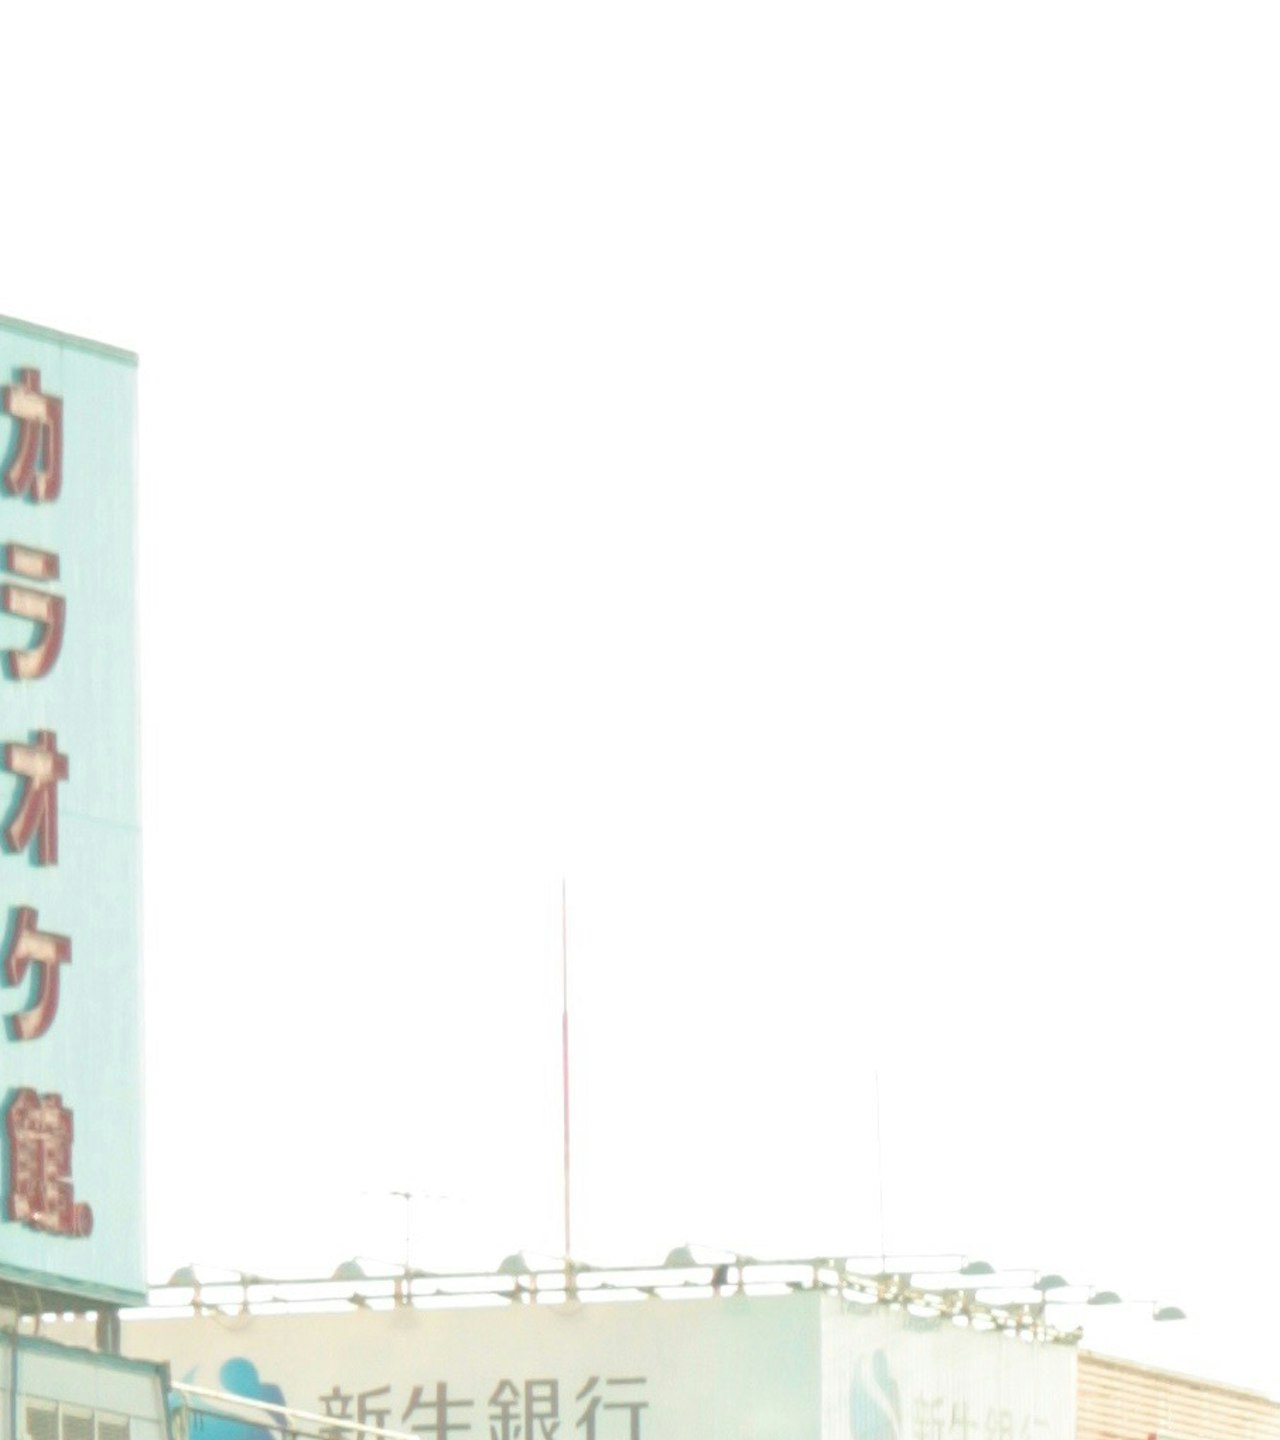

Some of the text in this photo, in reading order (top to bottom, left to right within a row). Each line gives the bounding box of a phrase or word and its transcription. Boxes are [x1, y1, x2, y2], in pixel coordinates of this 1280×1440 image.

[2, 365, 74, 1238] カラオケ館
